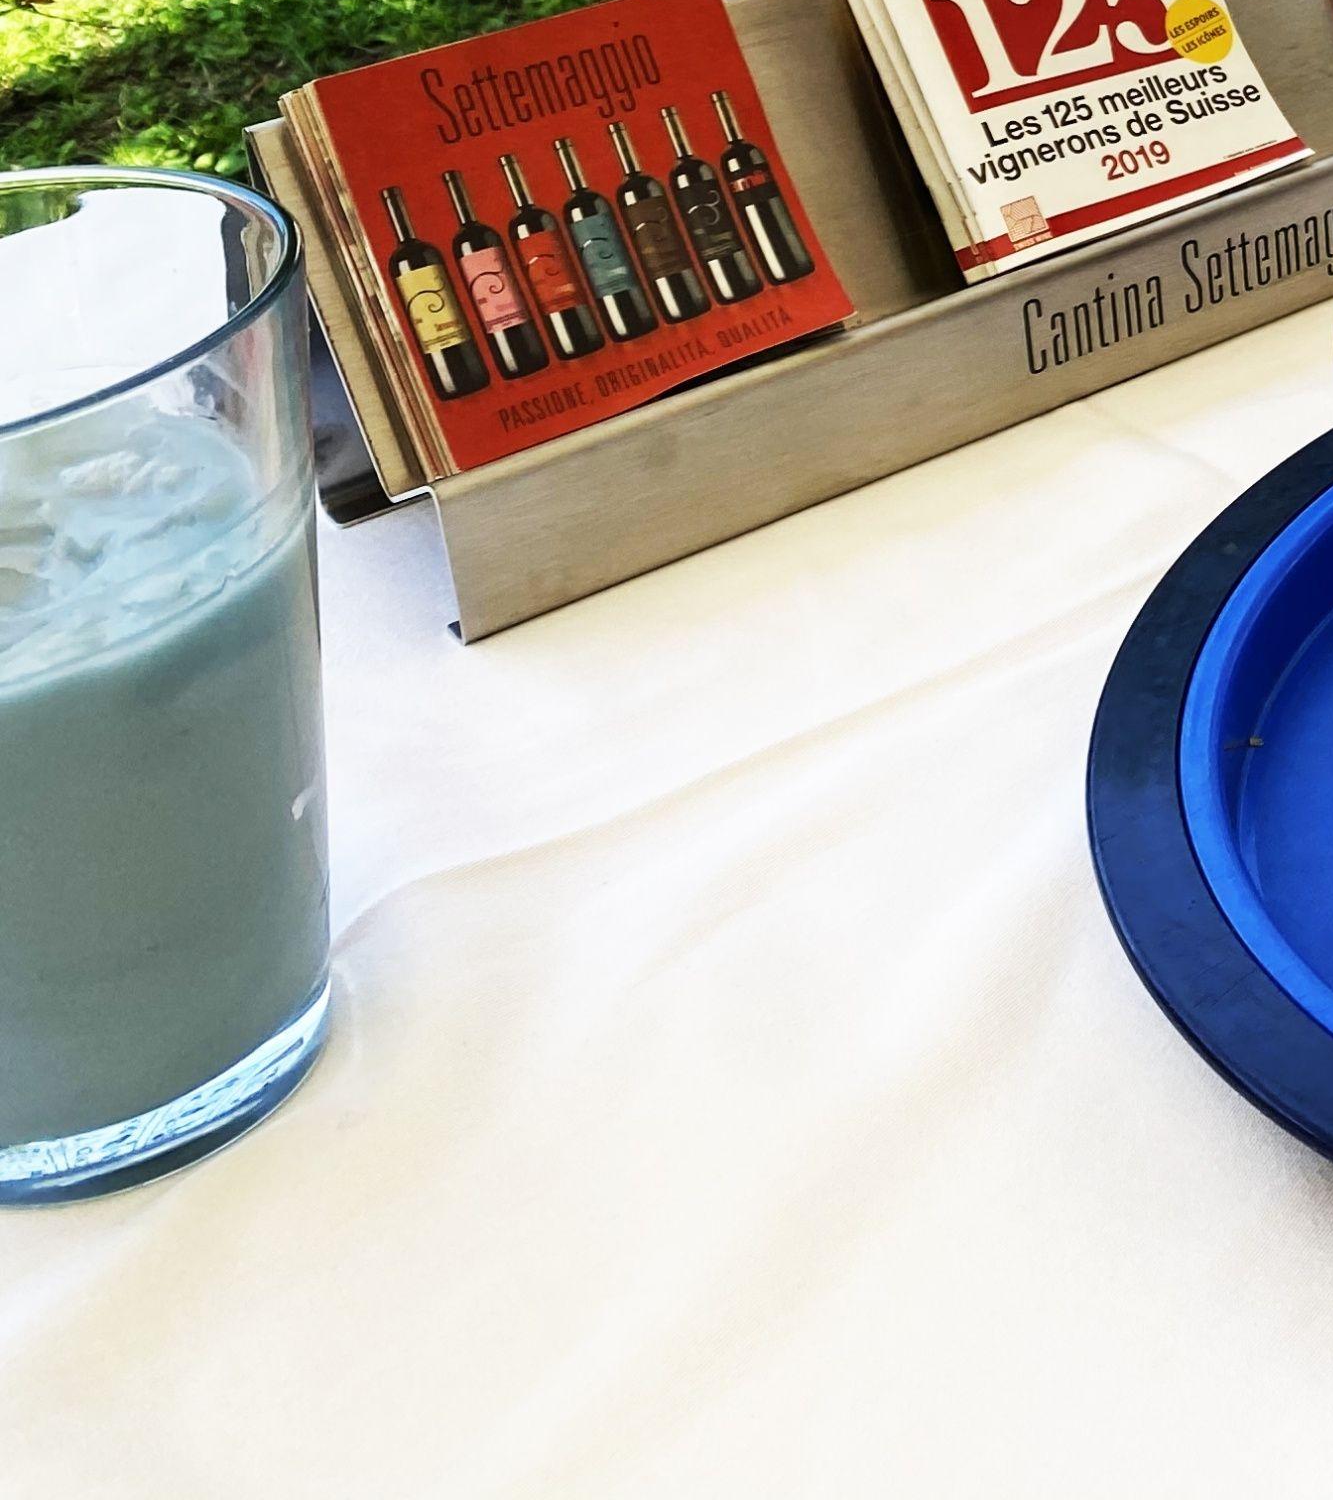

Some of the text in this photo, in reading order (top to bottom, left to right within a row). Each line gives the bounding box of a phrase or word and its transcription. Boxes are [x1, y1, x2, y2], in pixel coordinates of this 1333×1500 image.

[1169, 7, 1220, 39] LES ESPOIRS
[1181, 25, 1227, 54] LES ICÔNES
[420, 21, 661, 144] Settemaggio
[980, 65, 1228, 148] Les 125 meilleurs
[967, 84, 1262, 185] vignerons de Suisse
[1101, 140, 1171, 182] 2019
[1022, 272, 1166, 375] Cantina
